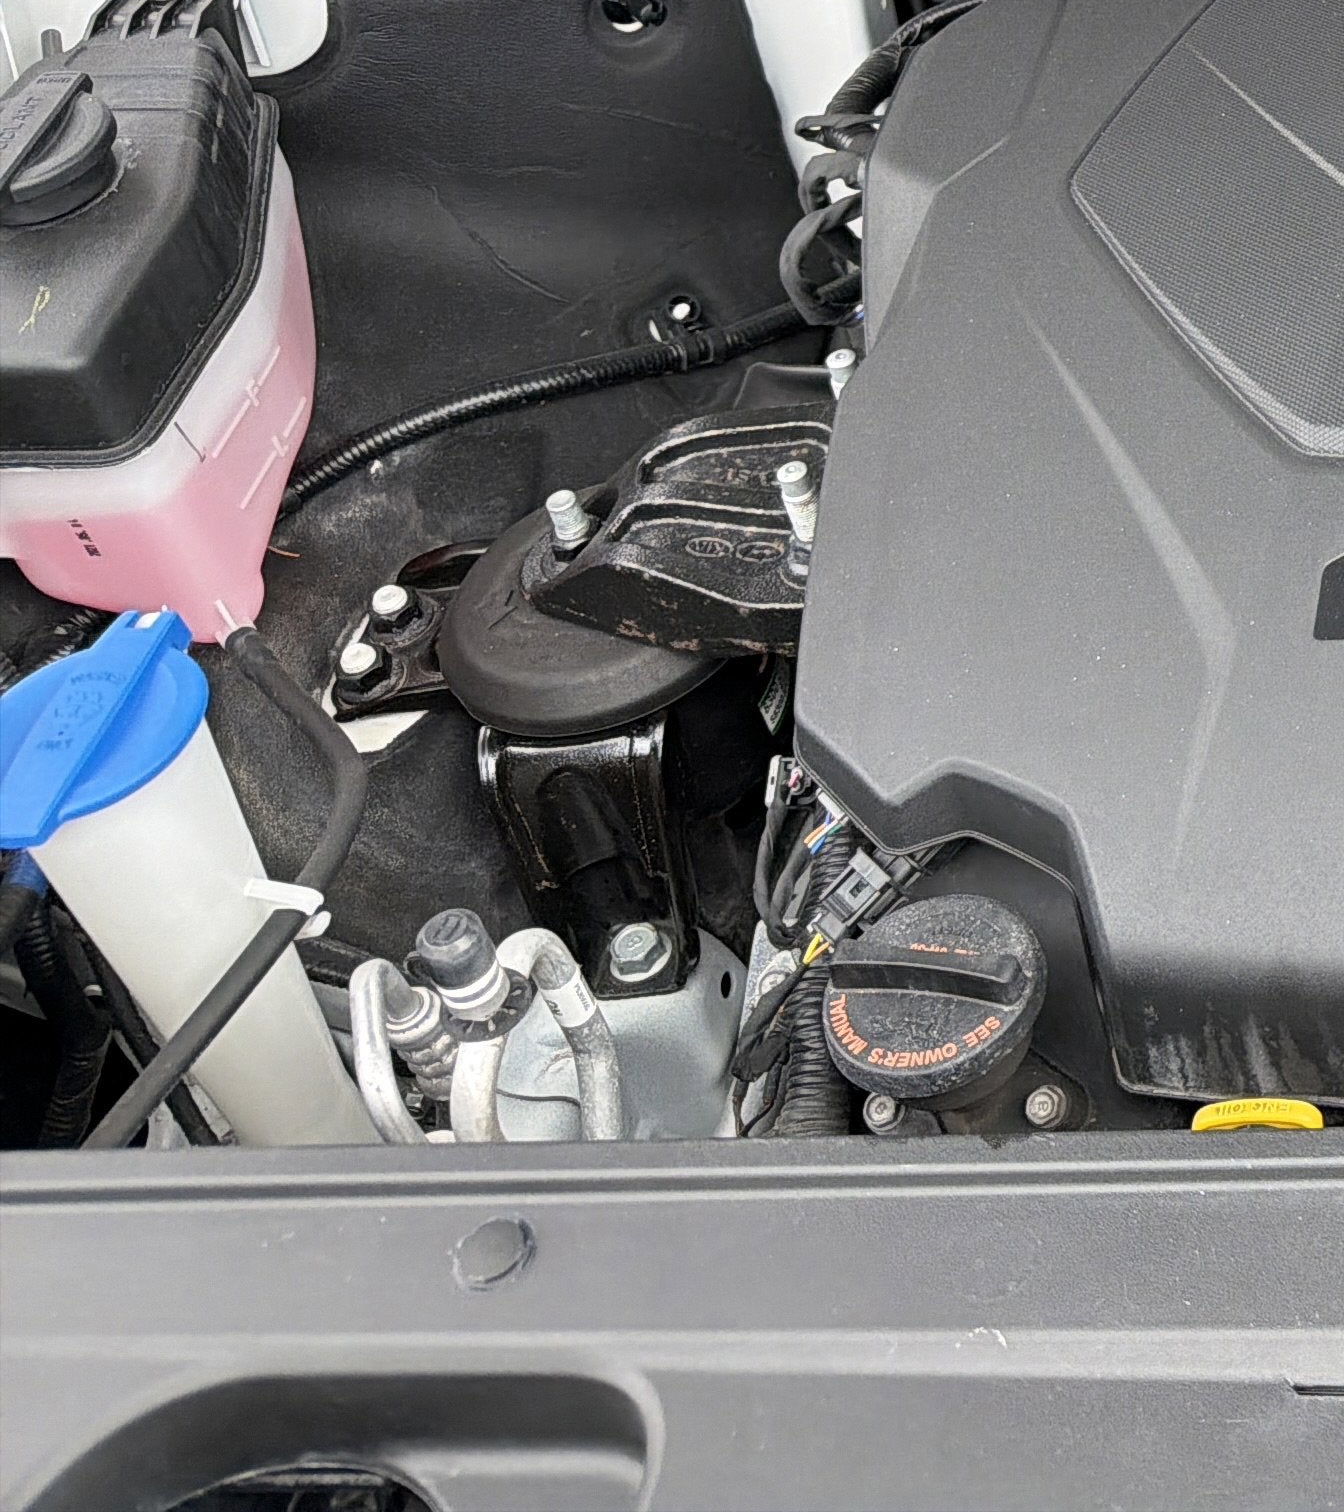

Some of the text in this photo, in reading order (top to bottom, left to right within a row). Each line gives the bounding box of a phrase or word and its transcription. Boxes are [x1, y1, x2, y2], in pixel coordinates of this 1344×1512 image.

[829, 993, 1001, 1068] SEE OWNER'S MANUAL
